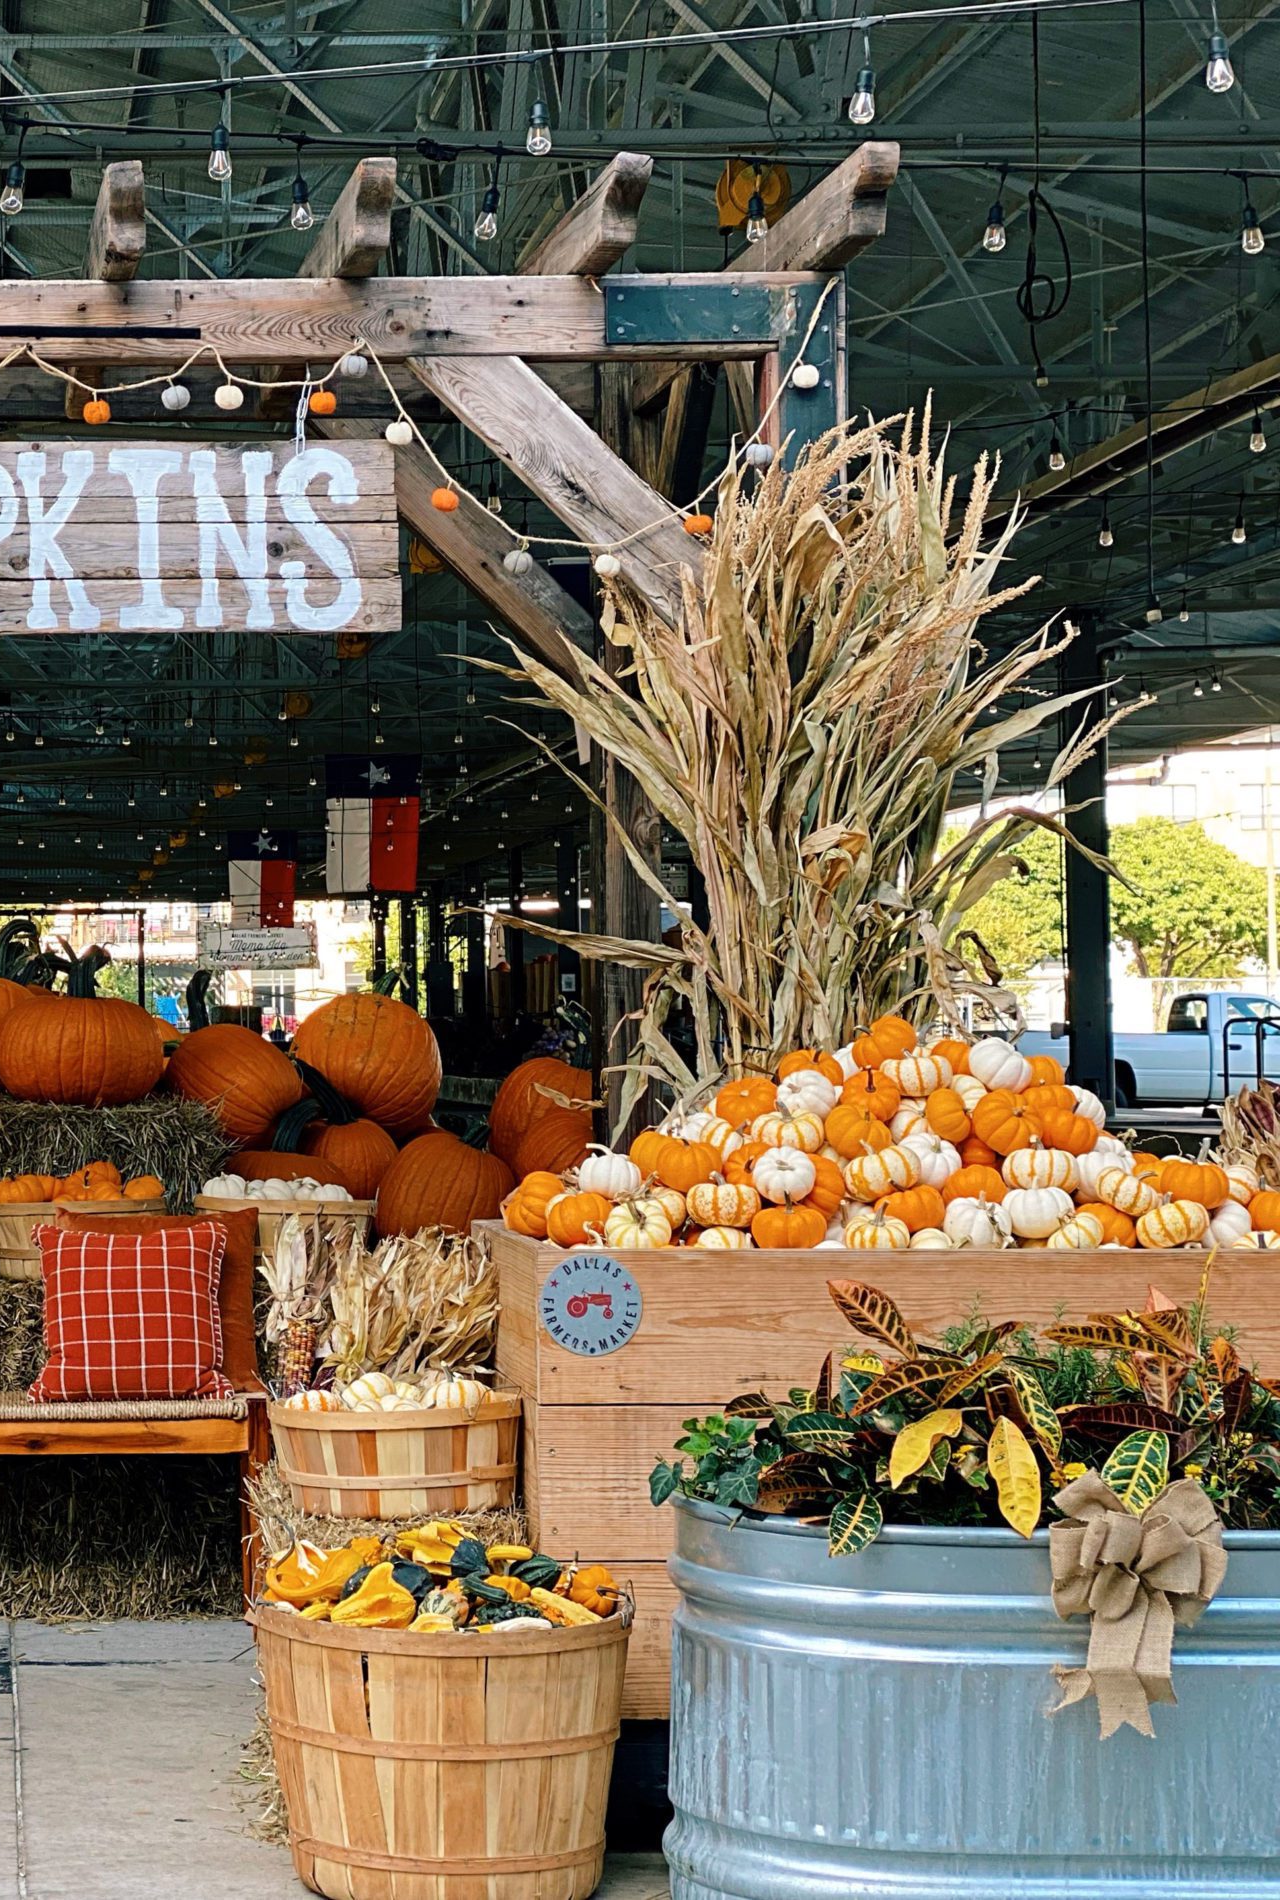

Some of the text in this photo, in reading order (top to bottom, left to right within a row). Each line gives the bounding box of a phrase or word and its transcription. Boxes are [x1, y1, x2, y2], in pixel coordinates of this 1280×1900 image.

[229, 939, 263, 951] Mama
[268, 951, 305, 964] Gden
[563, 1258, 622, 1278] DALLAS
[543, 1297, 639, 1351] FARMERS MARKET
